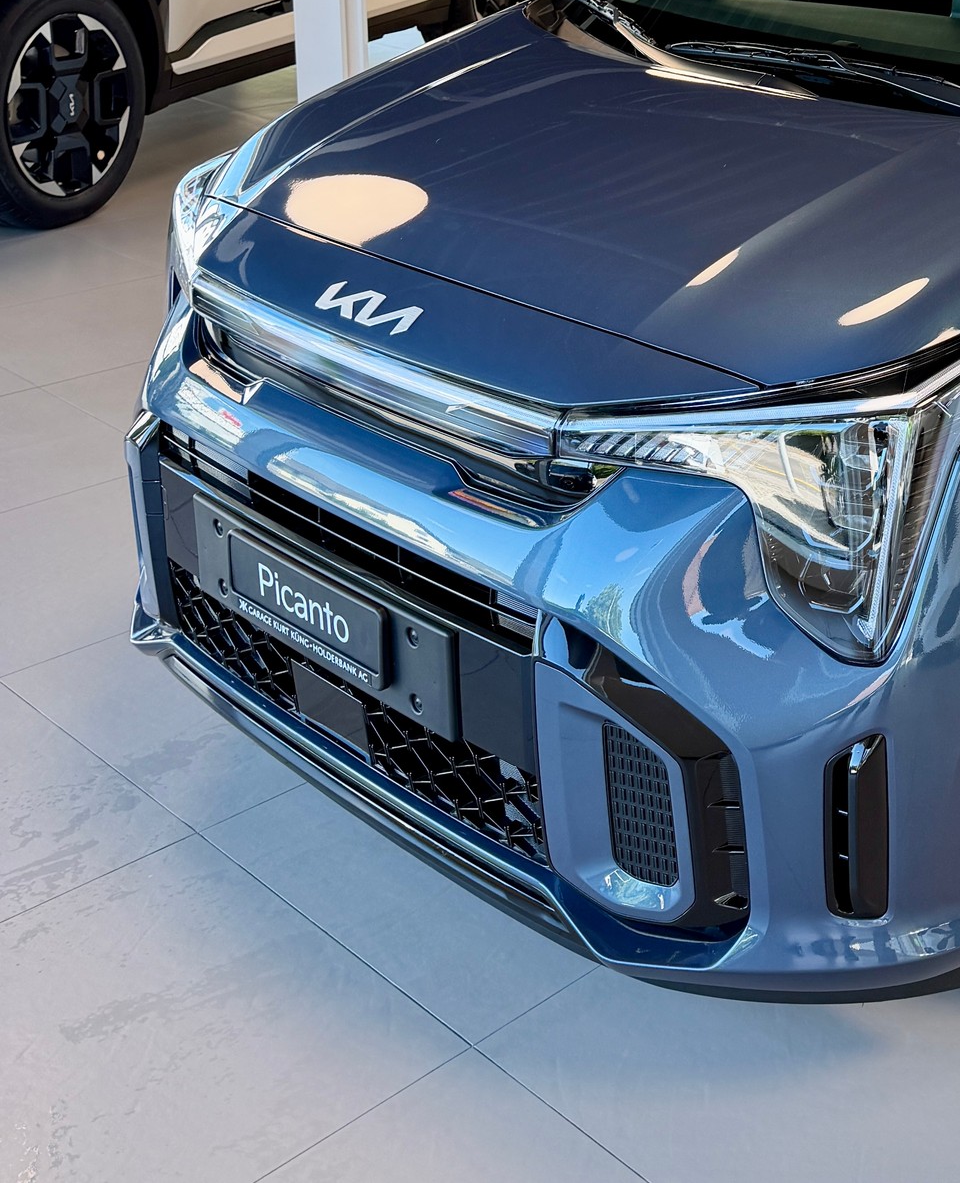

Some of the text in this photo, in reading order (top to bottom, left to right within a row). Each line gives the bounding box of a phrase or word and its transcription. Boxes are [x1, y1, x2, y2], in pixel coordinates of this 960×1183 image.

[314, 280, 424, 337] KIA
[257, 562, 350, 644] Picanto
[249, 605, 273, 627] GARAGE
[272, 619, 290, 636] KURT
[358, 670, 369, 683] AG
